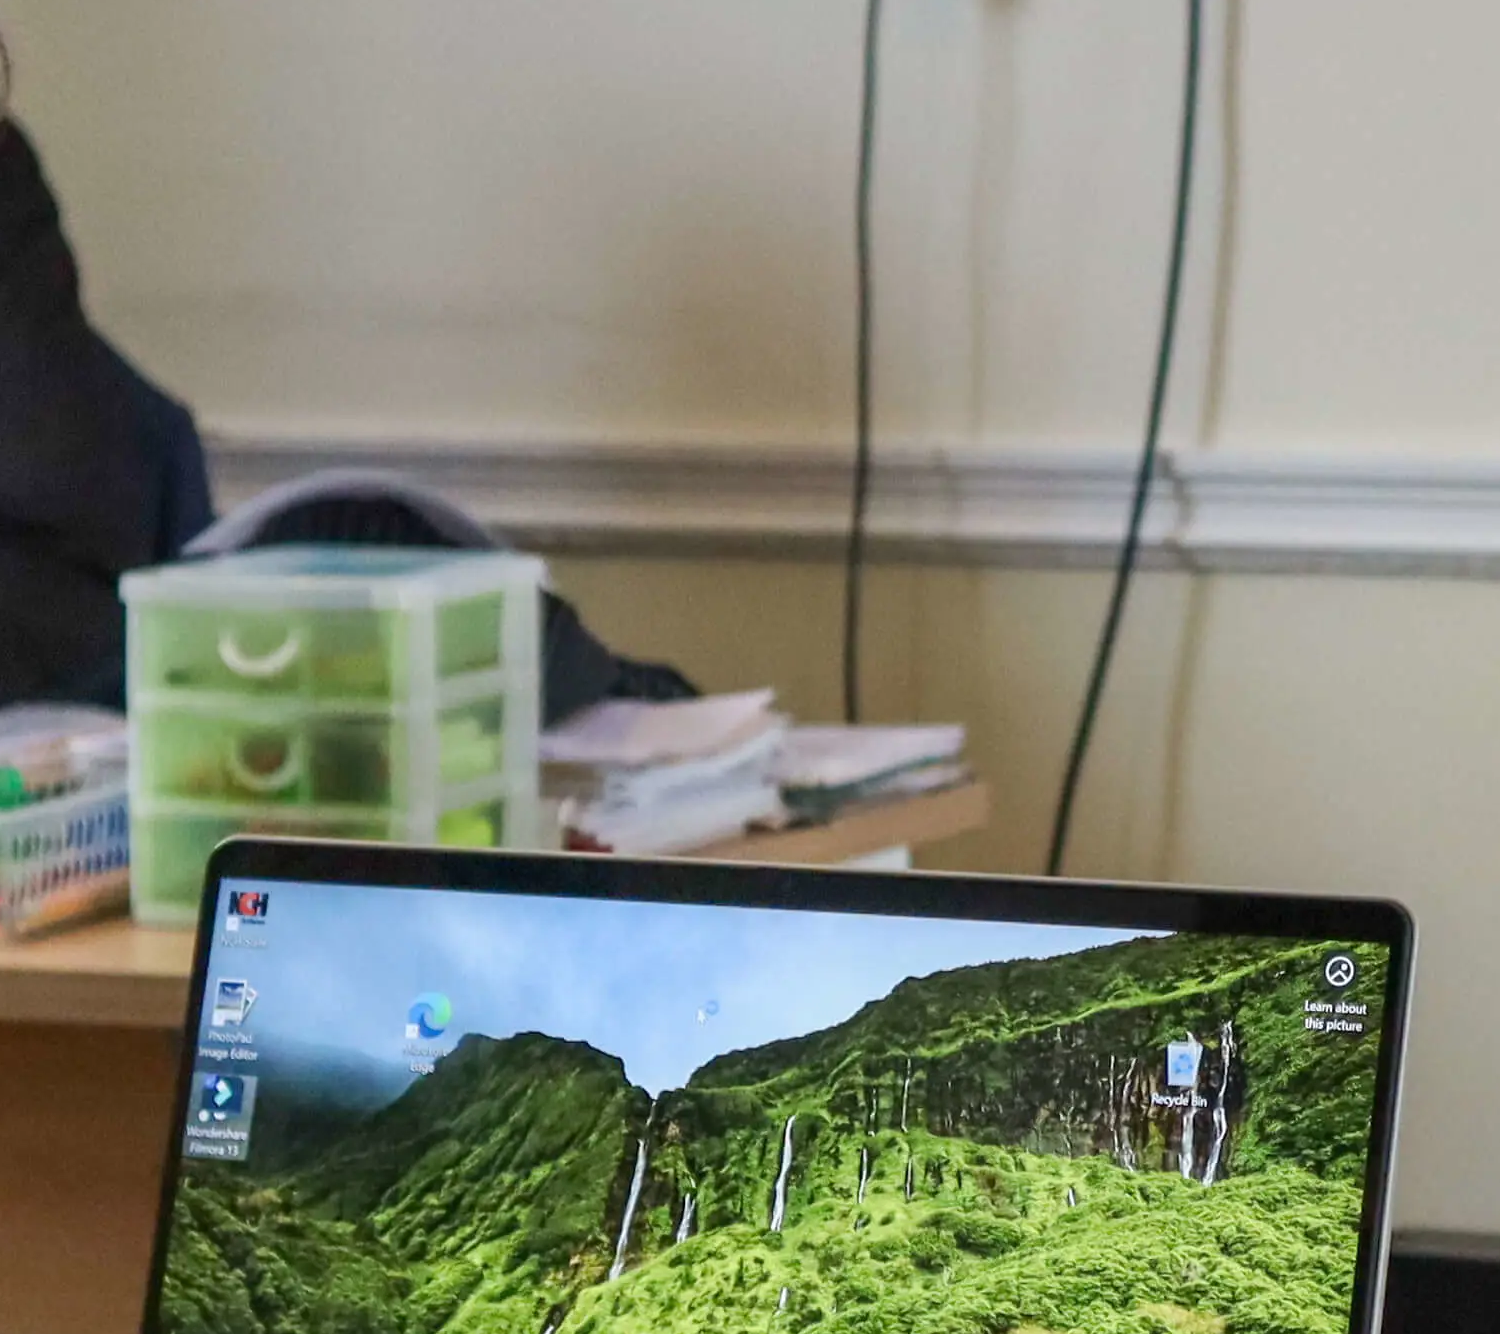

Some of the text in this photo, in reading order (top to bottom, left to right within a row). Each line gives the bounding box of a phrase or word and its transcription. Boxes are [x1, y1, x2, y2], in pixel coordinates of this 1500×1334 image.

[228, 891, 269, 917] NCH
[1304, 999, 1368, 1015] Learn about
[1304, 1016, 1363, 1033] this picture
[198, 1046, 259, 1062] Image Editor
[1151, 1090, 1208, 1108] Recycle Bin
[186, 1124, 248, 1141] Wondershare
[189, 1141, 225, 1156] Filmora
